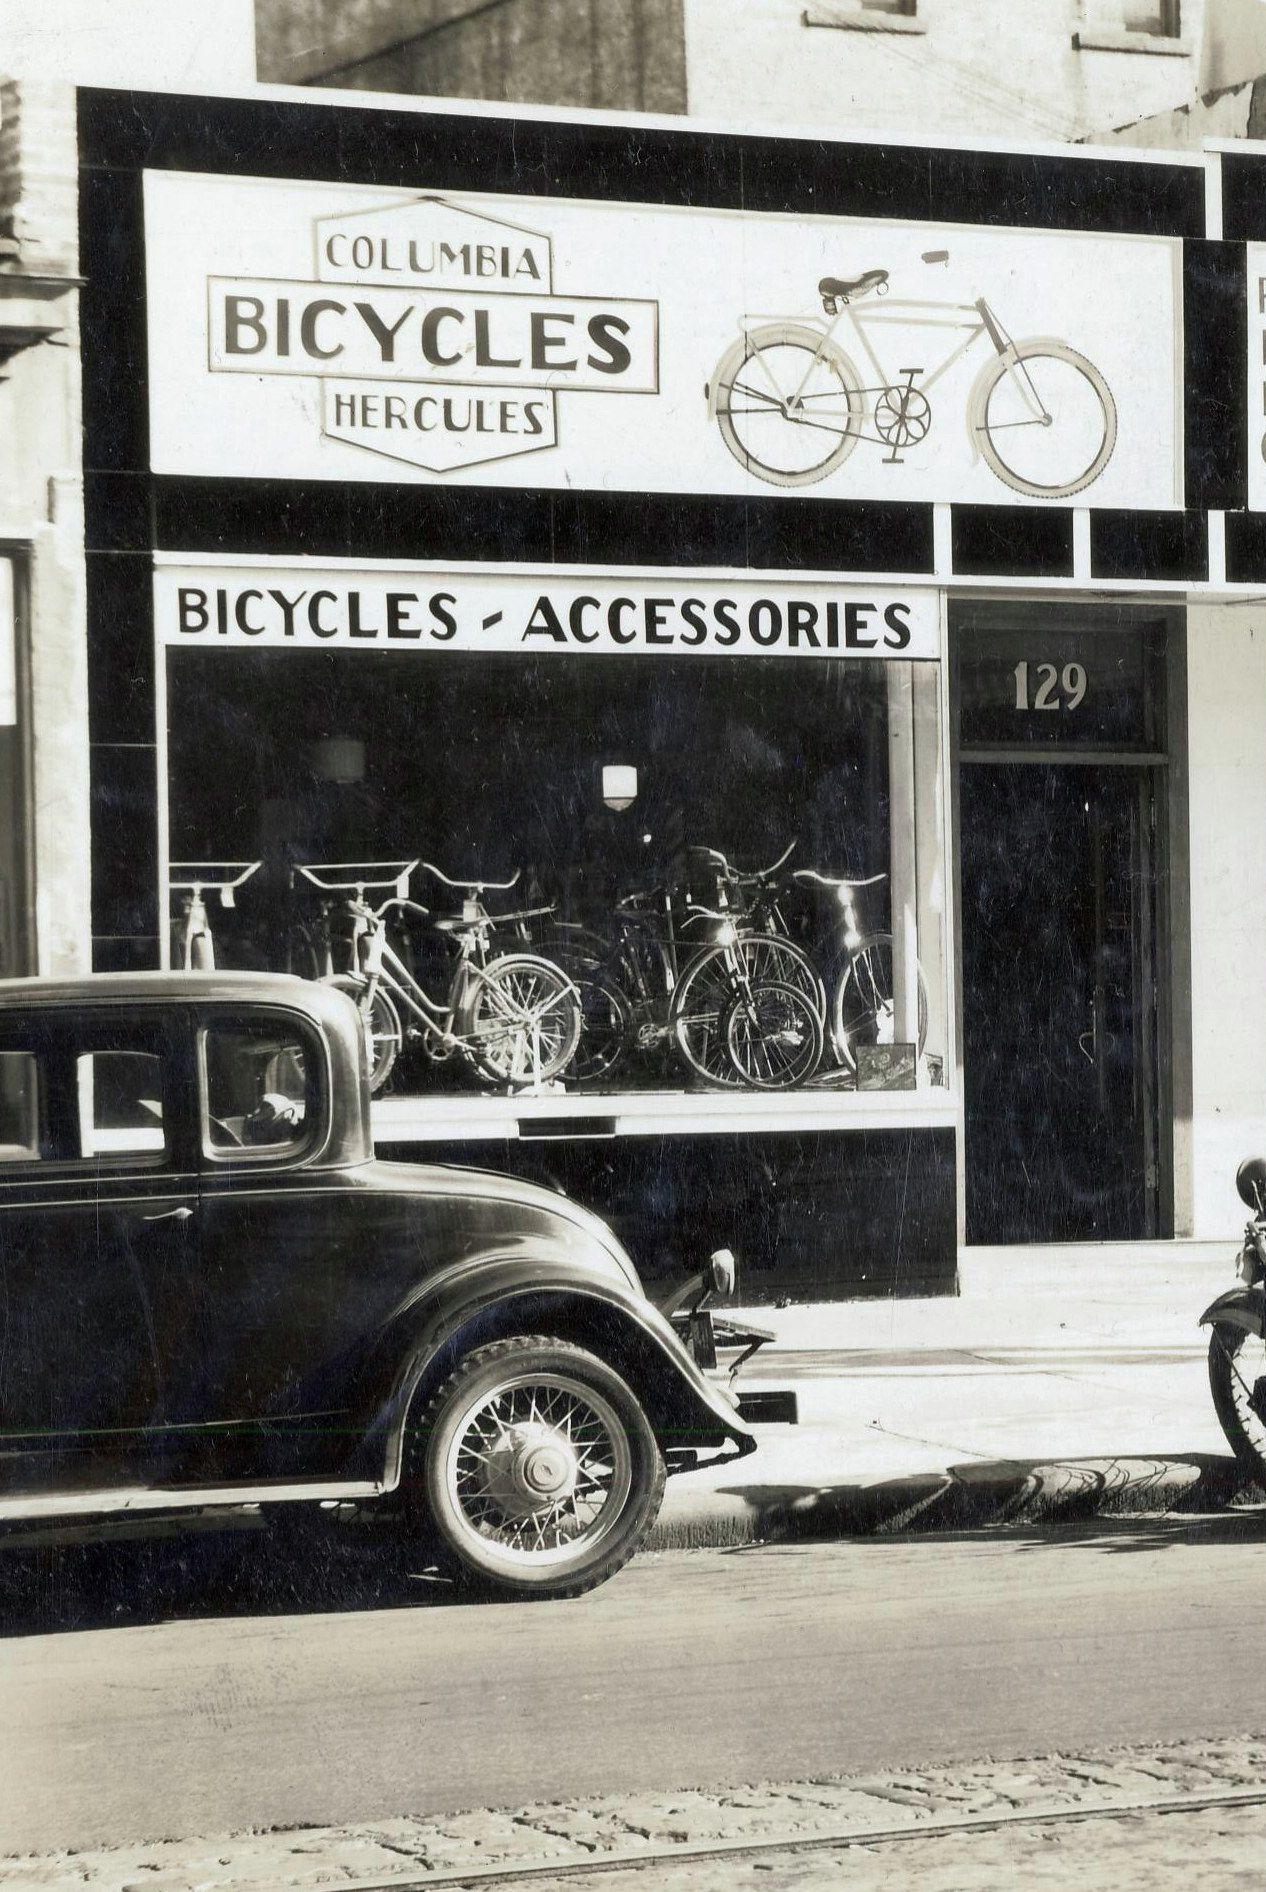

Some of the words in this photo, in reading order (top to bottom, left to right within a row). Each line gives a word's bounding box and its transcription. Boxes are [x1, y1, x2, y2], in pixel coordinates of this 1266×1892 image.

[325, 233, 542, 281] COLUMBIA
[224, 293, 633, 375] BICYCLES
[334, 392, 545, 436] HERCULES
[177, 586, 459, 642] BICYCLES
[521, 595, 913, 650] ACCESSORIES
[1013, 660, 1088, 711] 129
